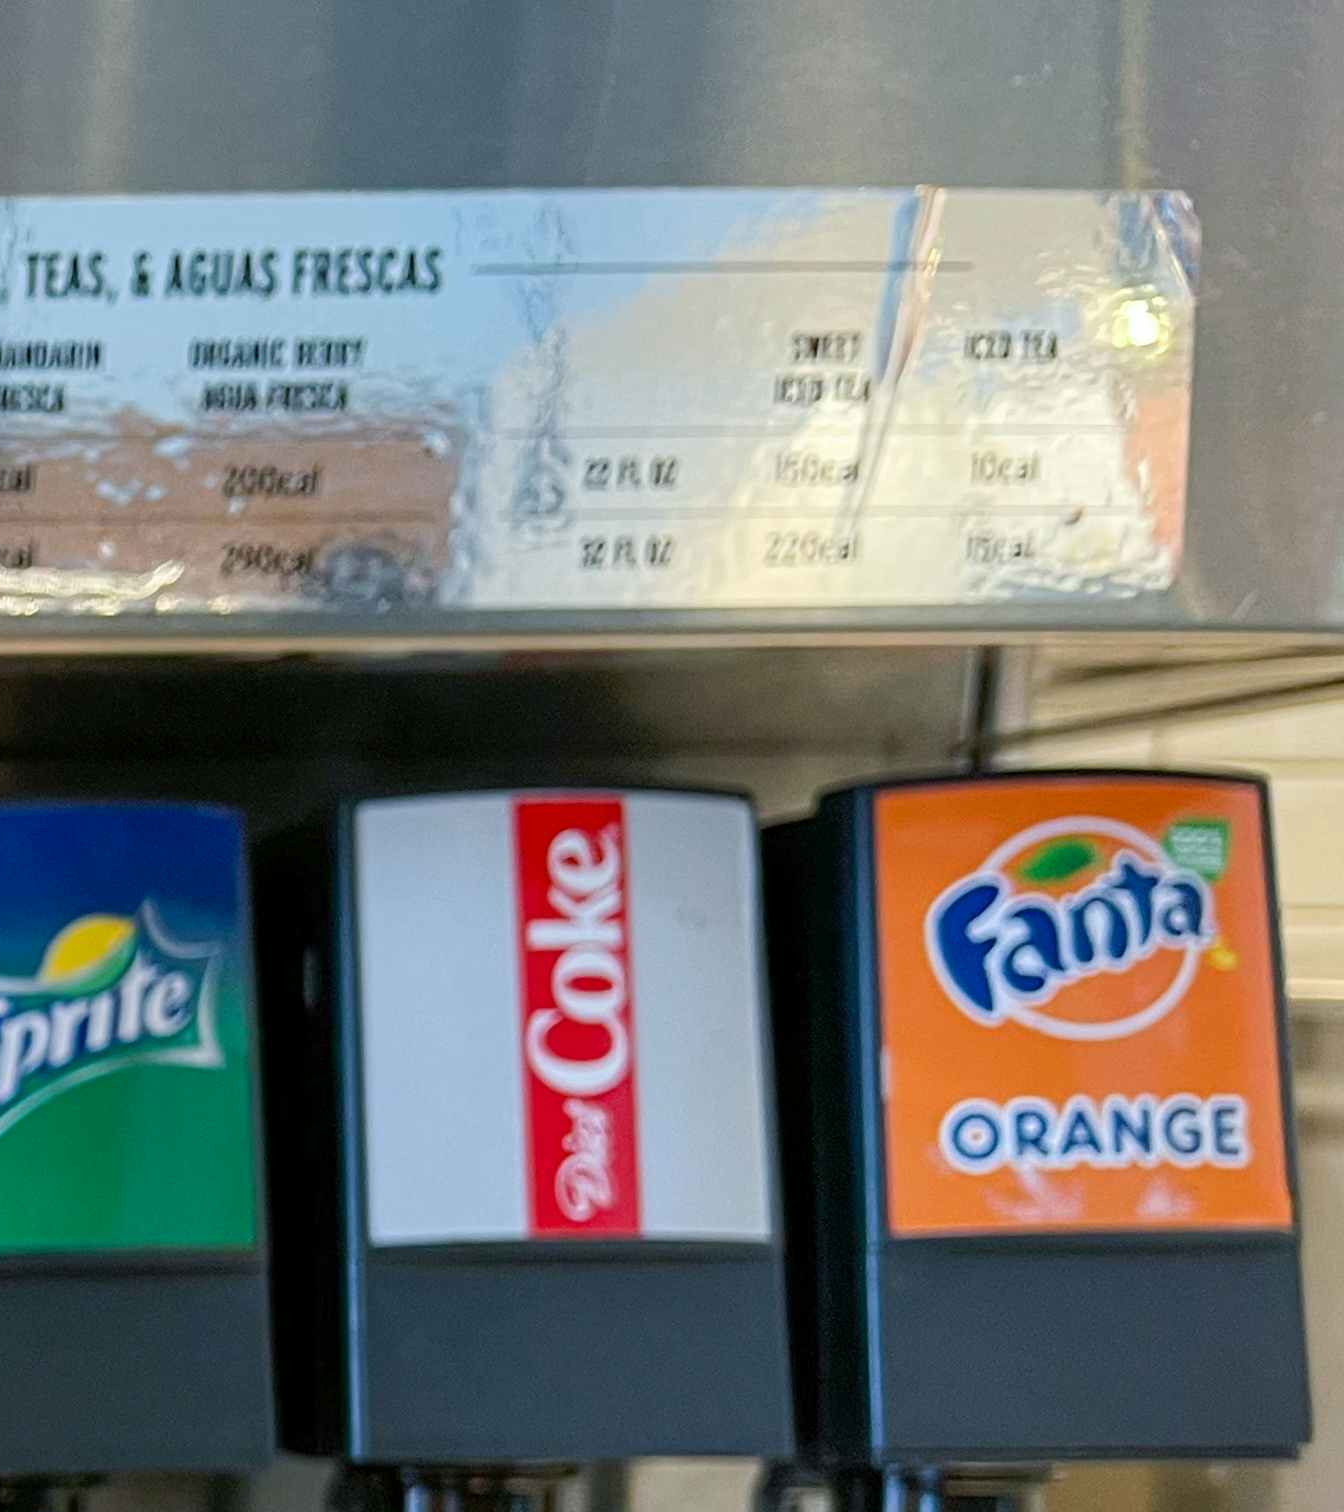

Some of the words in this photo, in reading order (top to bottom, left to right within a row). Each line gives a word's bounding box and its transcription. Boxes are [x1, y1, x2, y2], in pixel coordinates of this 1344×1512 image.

[26, 252, 117, 303] TEAS,
[130, 252, 150, 297] &
[166, 250, 279, 298] AGUAS
[292, 247, 442, 295] FRESCAS
[526, 822, 630, 1097] Coke
[931, 856, 1209, 1020] Fanta
[946, 1098, 1247, 1167] ORANGE
